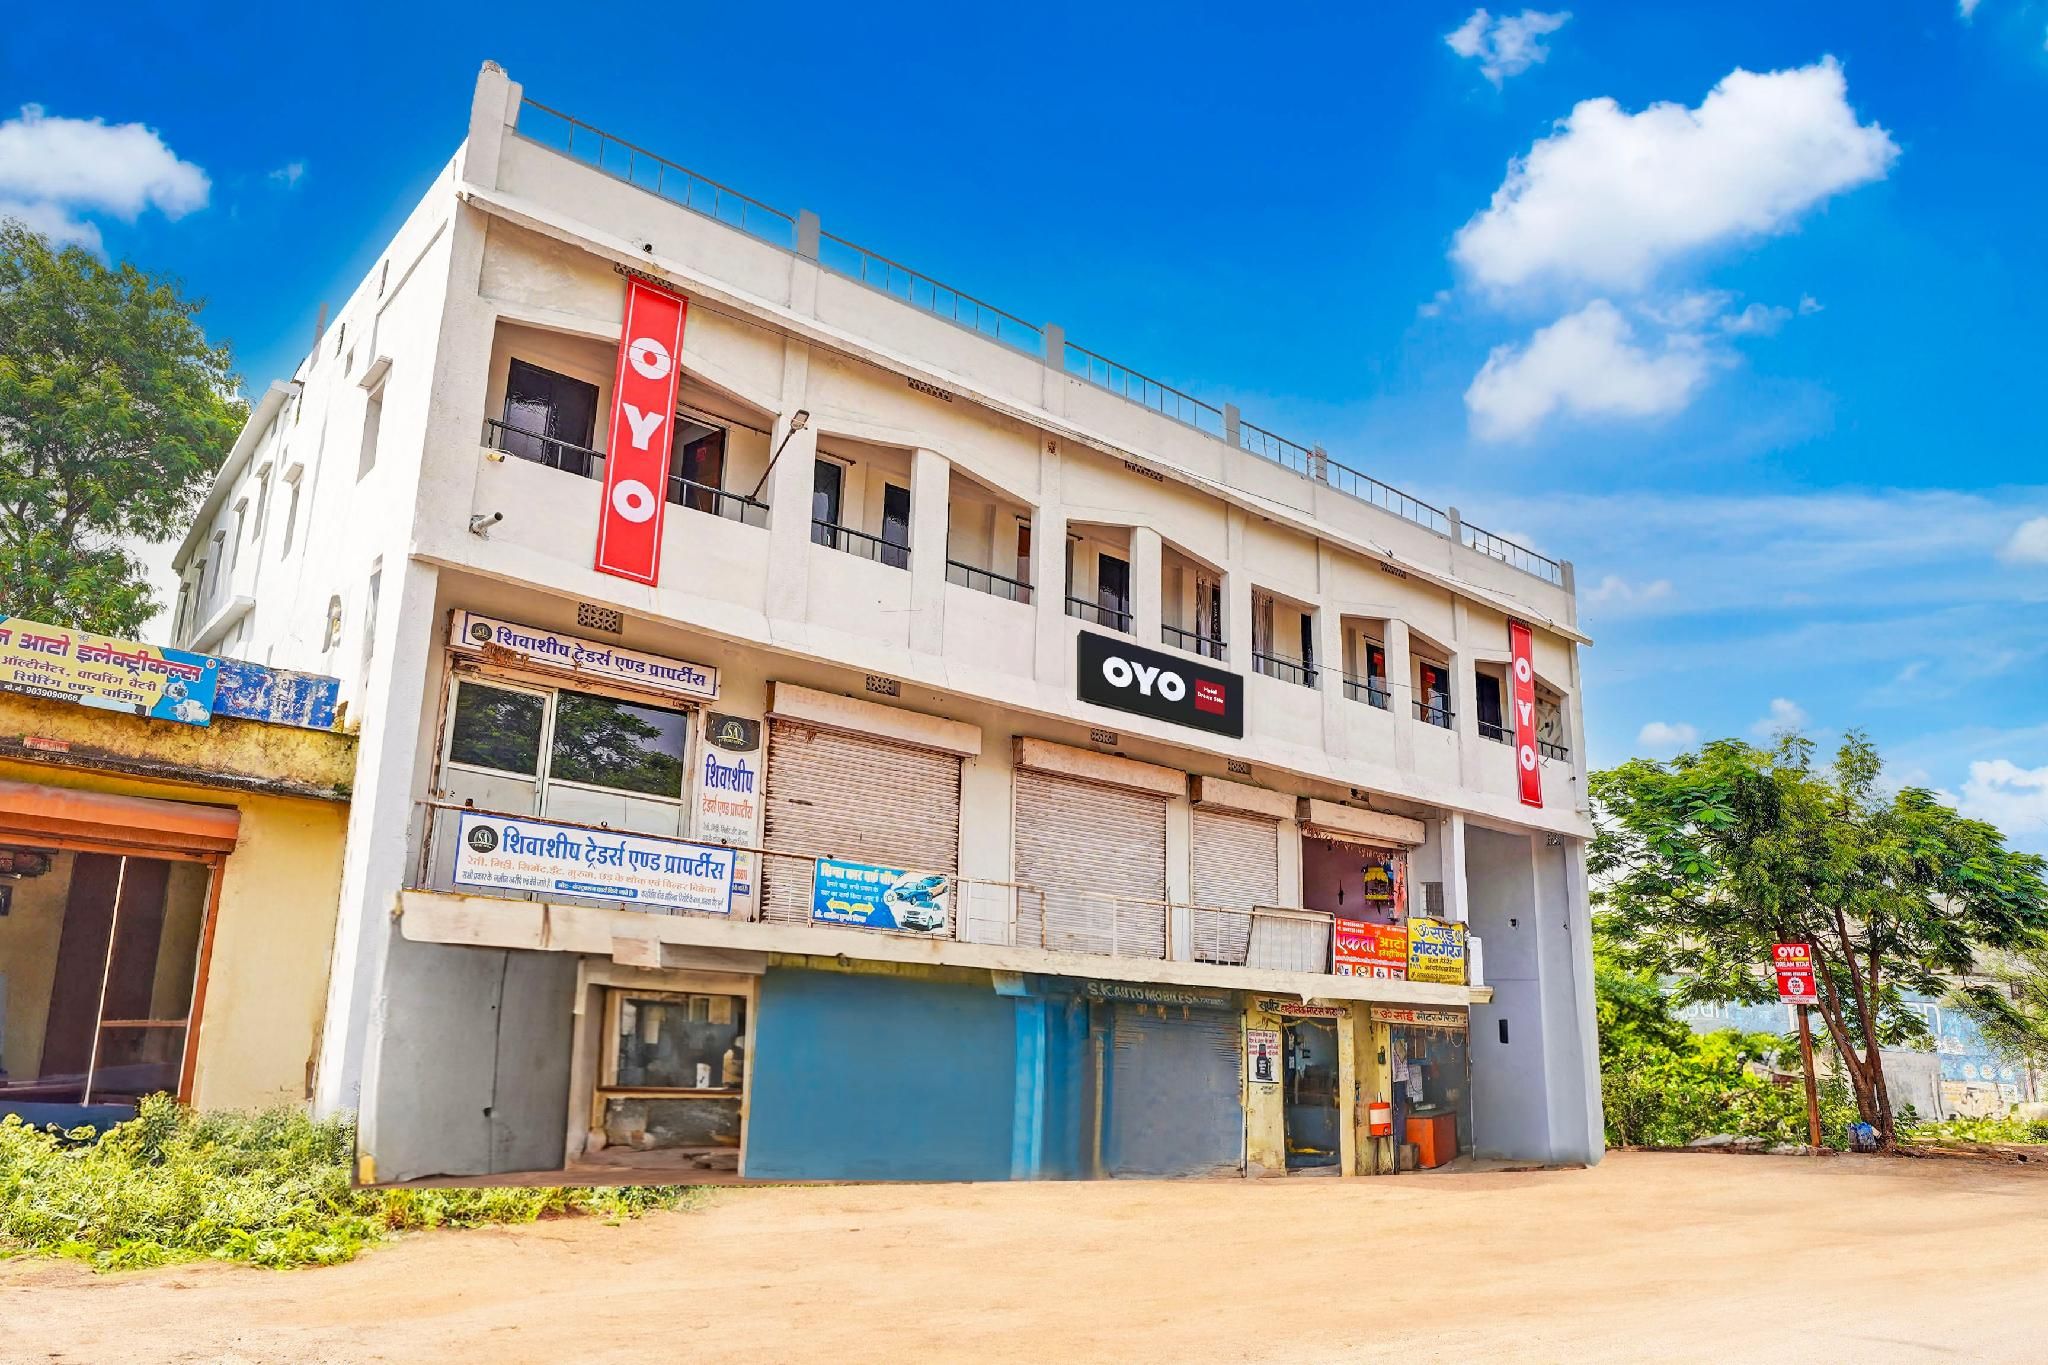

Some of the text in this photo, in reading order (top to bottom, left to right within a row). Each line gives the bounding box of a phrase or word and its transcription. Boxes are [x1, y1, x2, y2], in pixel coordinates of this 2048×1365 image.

[612, 337, 671, 523] OYO
[19, 633, 71, 656] आटो
[496, 626, 571, 658] शिवाशीष
[615, 655, 646, 672] एण्ड
[68, 682, 95, 693] एण्ड
[1102, 656, 1186, 702] OYO
[1516, 657, 1536, 771] OYO
[502, 825, 725, 880] शिवाशीष ट्रेडर्स एण्ड प्रापर्टीस
[1412, 939, 1438, 956] मोटर
[1778, 946, 1805, 957] OYO
